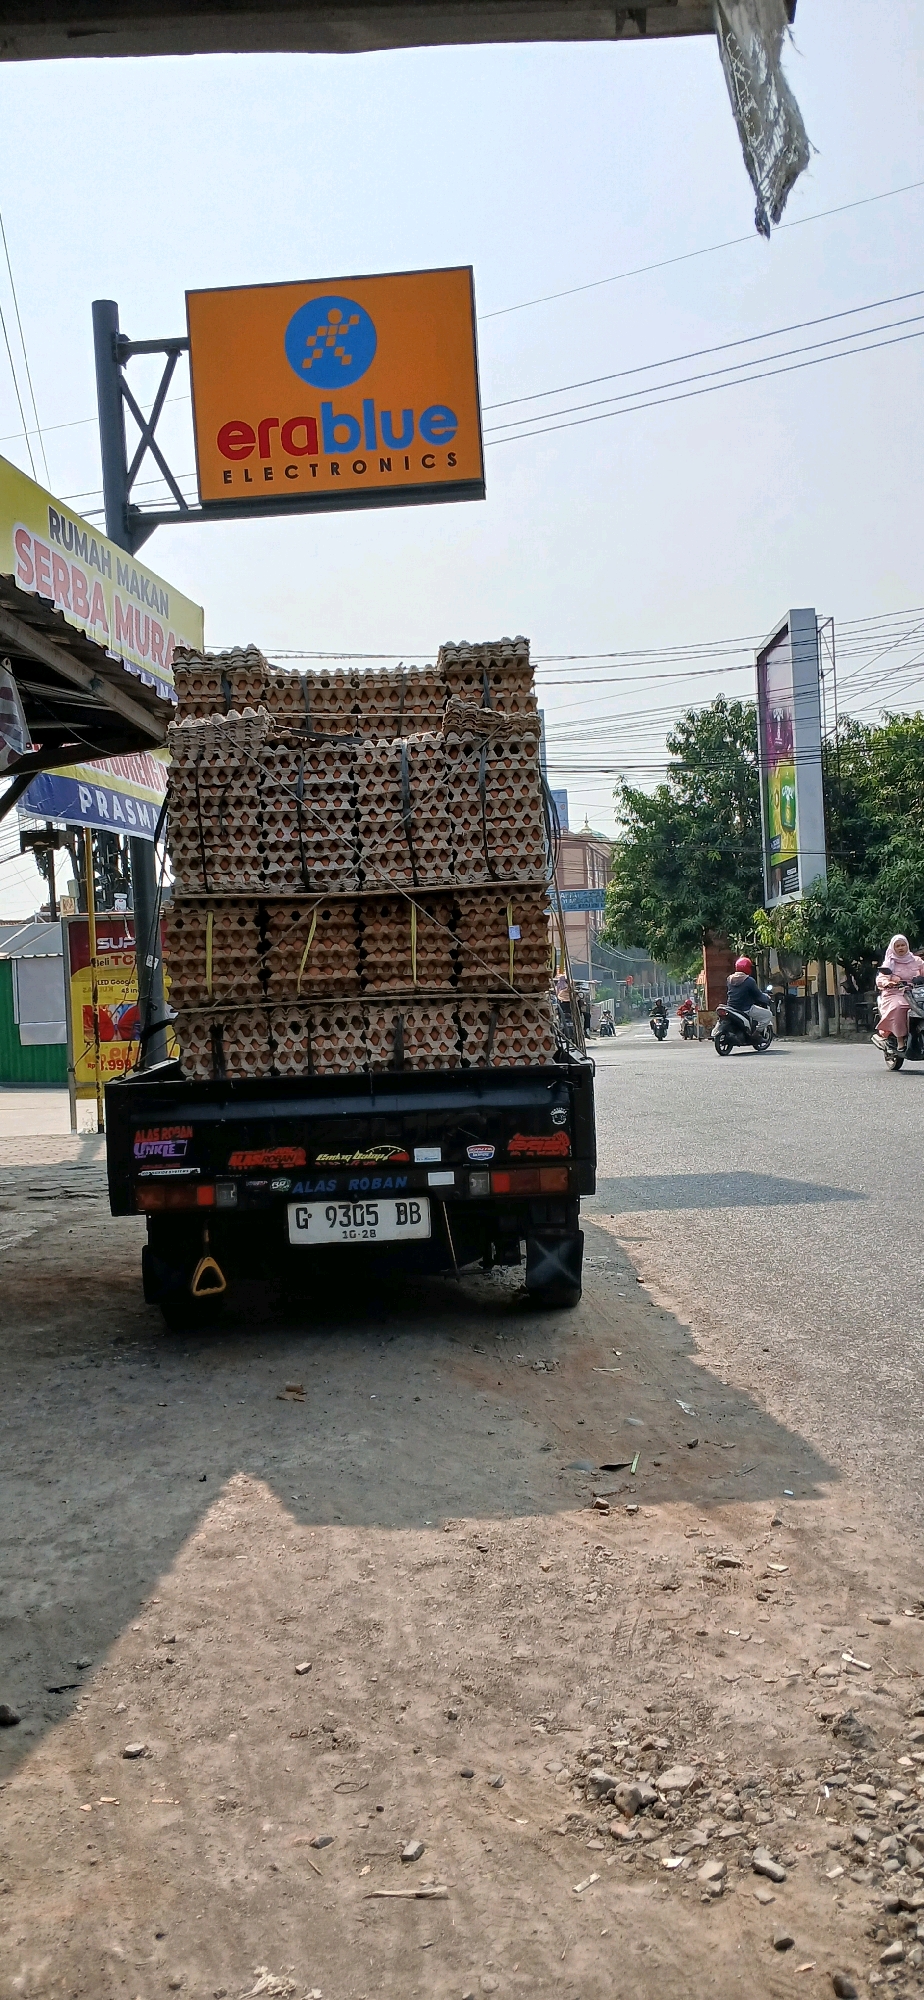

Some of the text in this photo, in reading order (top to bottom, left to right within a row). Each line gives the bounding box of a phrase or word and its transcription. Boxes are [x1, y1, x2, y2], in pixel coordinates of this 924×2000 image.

[217, 398, 458, 461] erablue
[223, 452, 457, 484] ELECTRONICS
[48, 506, 170, 619] RUMAH MAKAN
[14, 528, 190, 669] SERBA MURA
[292, 1179, 337, 1194] ALAS
[348, 1176, 408, 1191] ROBAN
[295, 1207, 309, 1229] G
[325, 1203, 379, 1228] 9305
